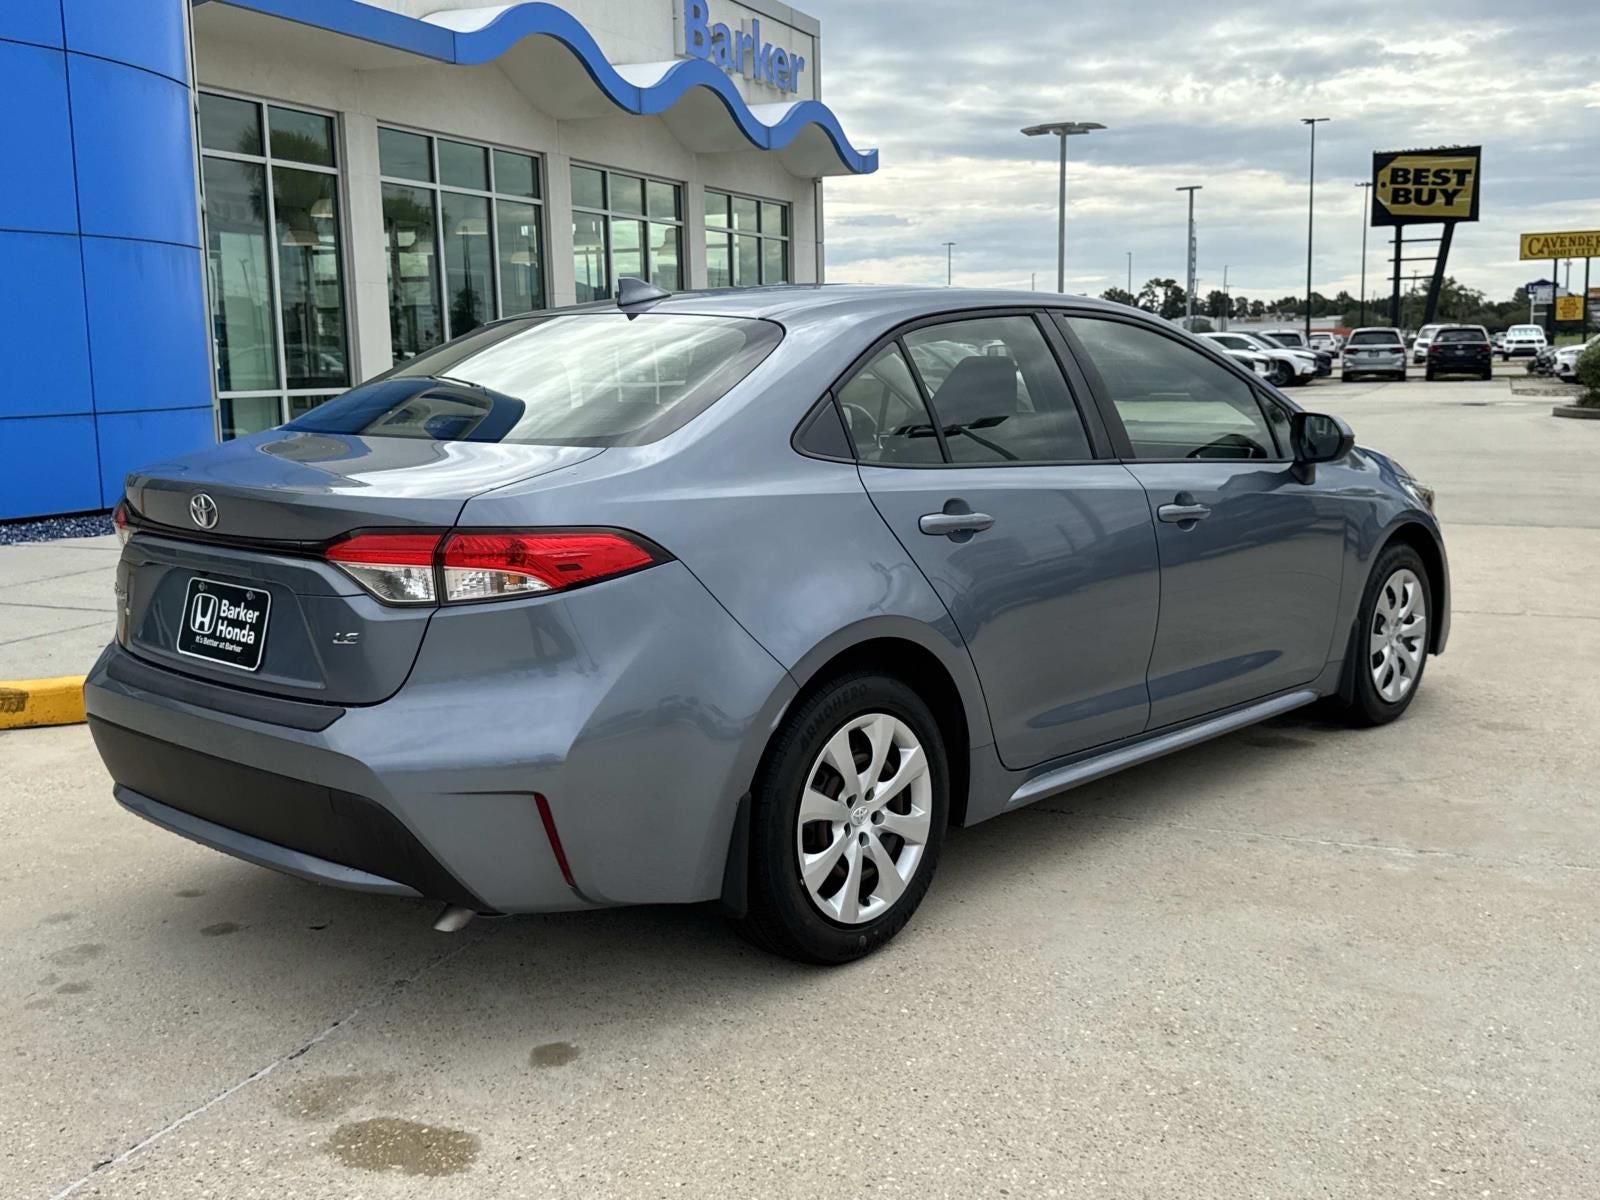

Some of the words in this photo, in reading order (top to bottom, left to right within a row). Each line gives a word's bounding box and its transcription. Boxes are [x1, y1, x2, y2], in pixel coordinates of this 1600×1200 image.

[683, 0, 805, 94] Barker
[1389, 168, 1472, 187] BEST
[1390, 188, 1463, 207] BUY
[219, 599, 260, 624] Barker
[216, 619, 255, 644] Honda
[332, 632, 360, 645] LE
[203, 636, 219, 647] Better
[225, 642, 243, 653] Barker
